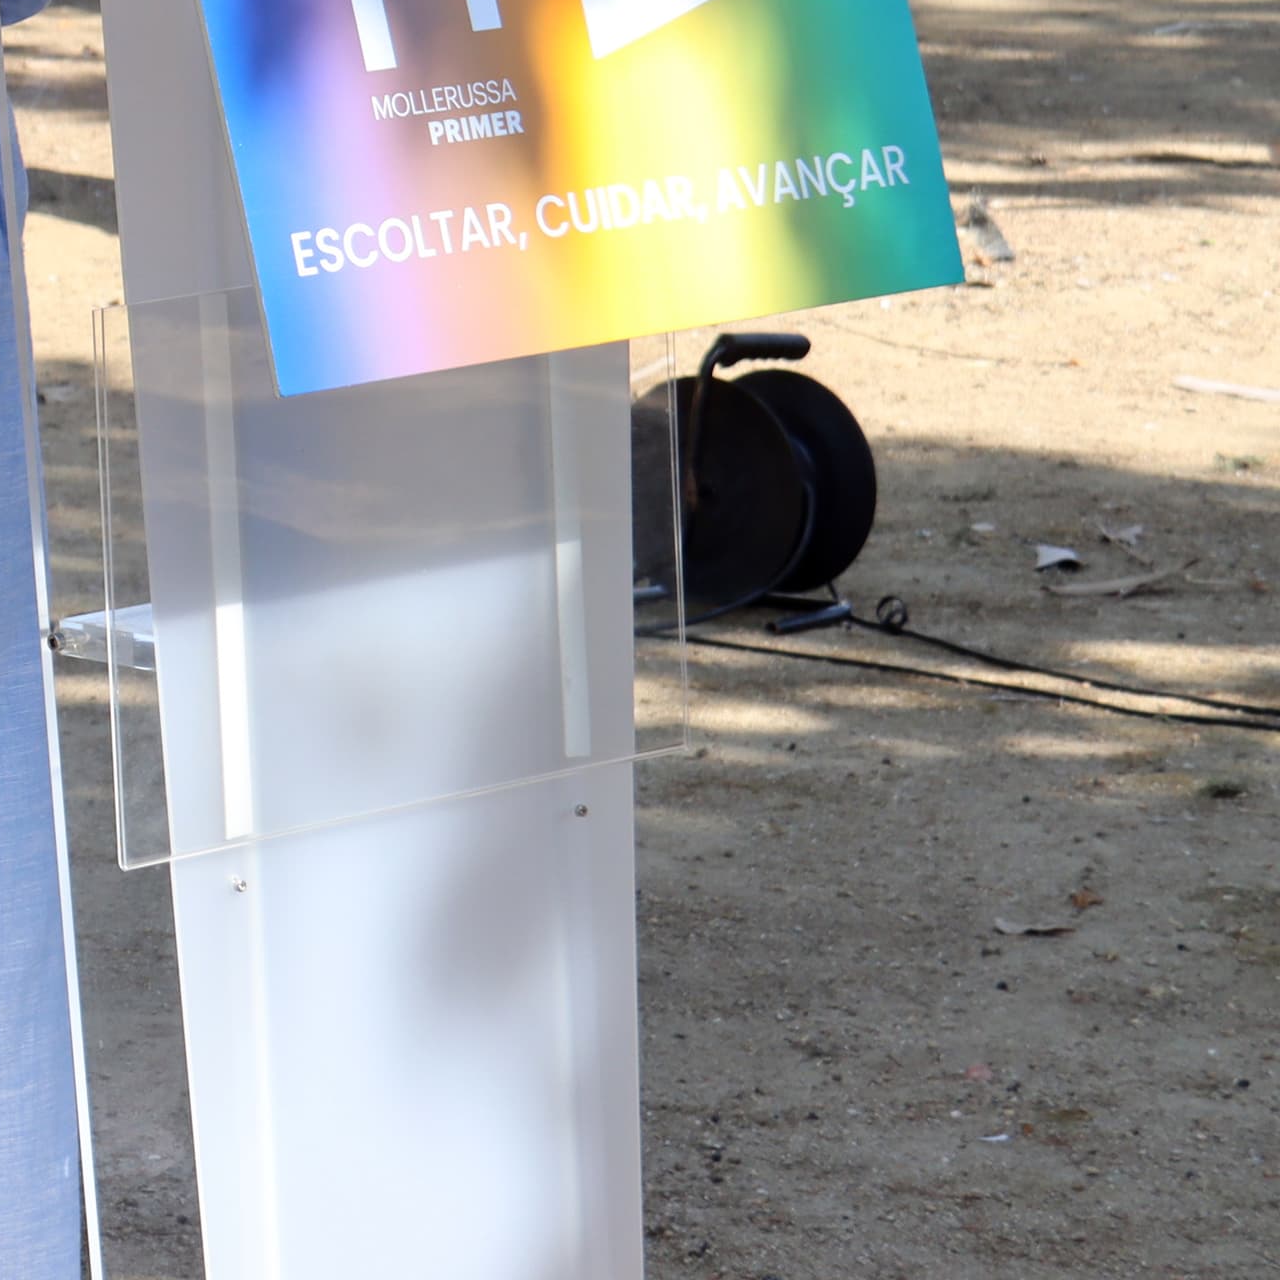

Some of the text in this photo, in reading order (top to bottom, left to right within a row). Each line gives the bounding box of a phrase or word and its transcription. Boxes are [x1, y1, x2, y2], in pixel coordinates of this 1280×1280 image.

[372, 79, 518, 121] MOLLERUSSA
[429, 111, 524, 145] PRIMER
[291, 145, 910, 276] ESCOLTAR, CUIDAR, AVANÇAR
